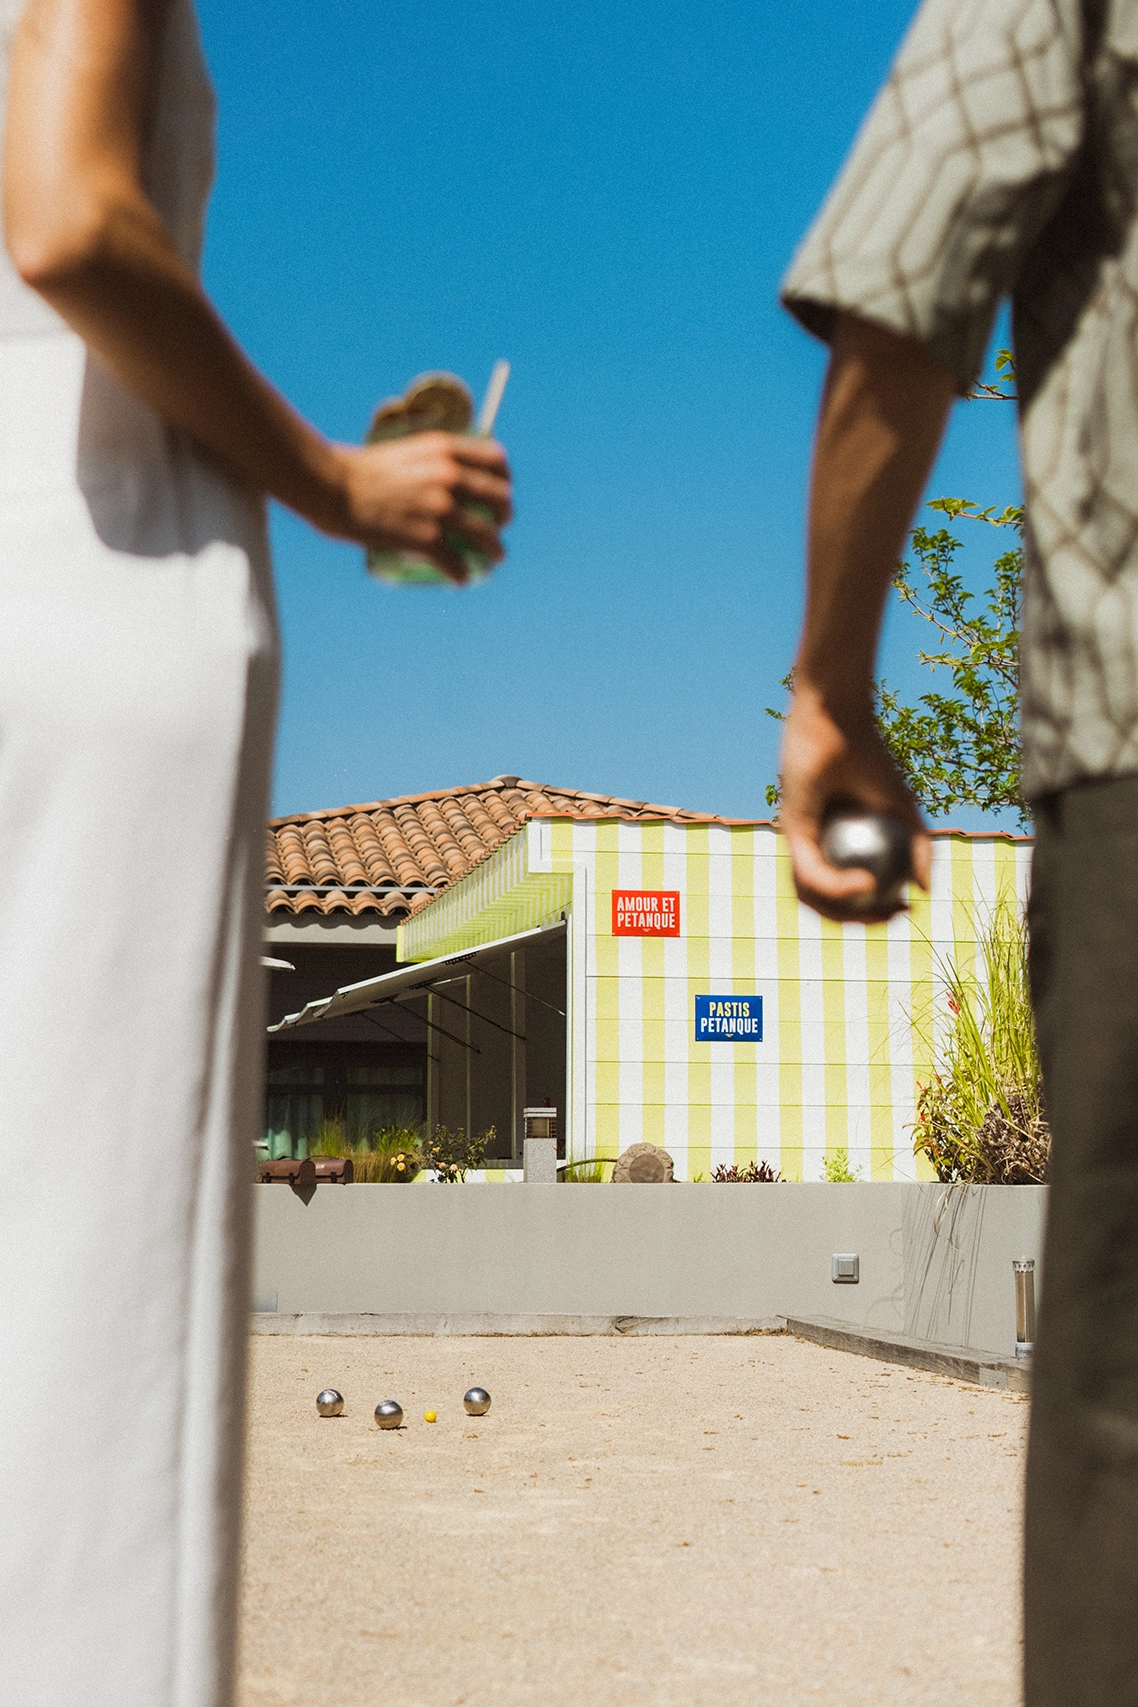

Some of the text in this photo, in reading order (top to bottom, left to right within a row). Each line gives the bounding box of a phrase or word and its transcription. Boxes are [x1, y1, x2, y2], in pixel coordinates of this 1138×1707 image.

[616, 896, 675, 912] AMOUR ET
[617, 912, 675, 930] PETANQUE
[709, 1002, 750, 1017] PASTIS
[700, 1017, 758, 1035] PETANQUE
